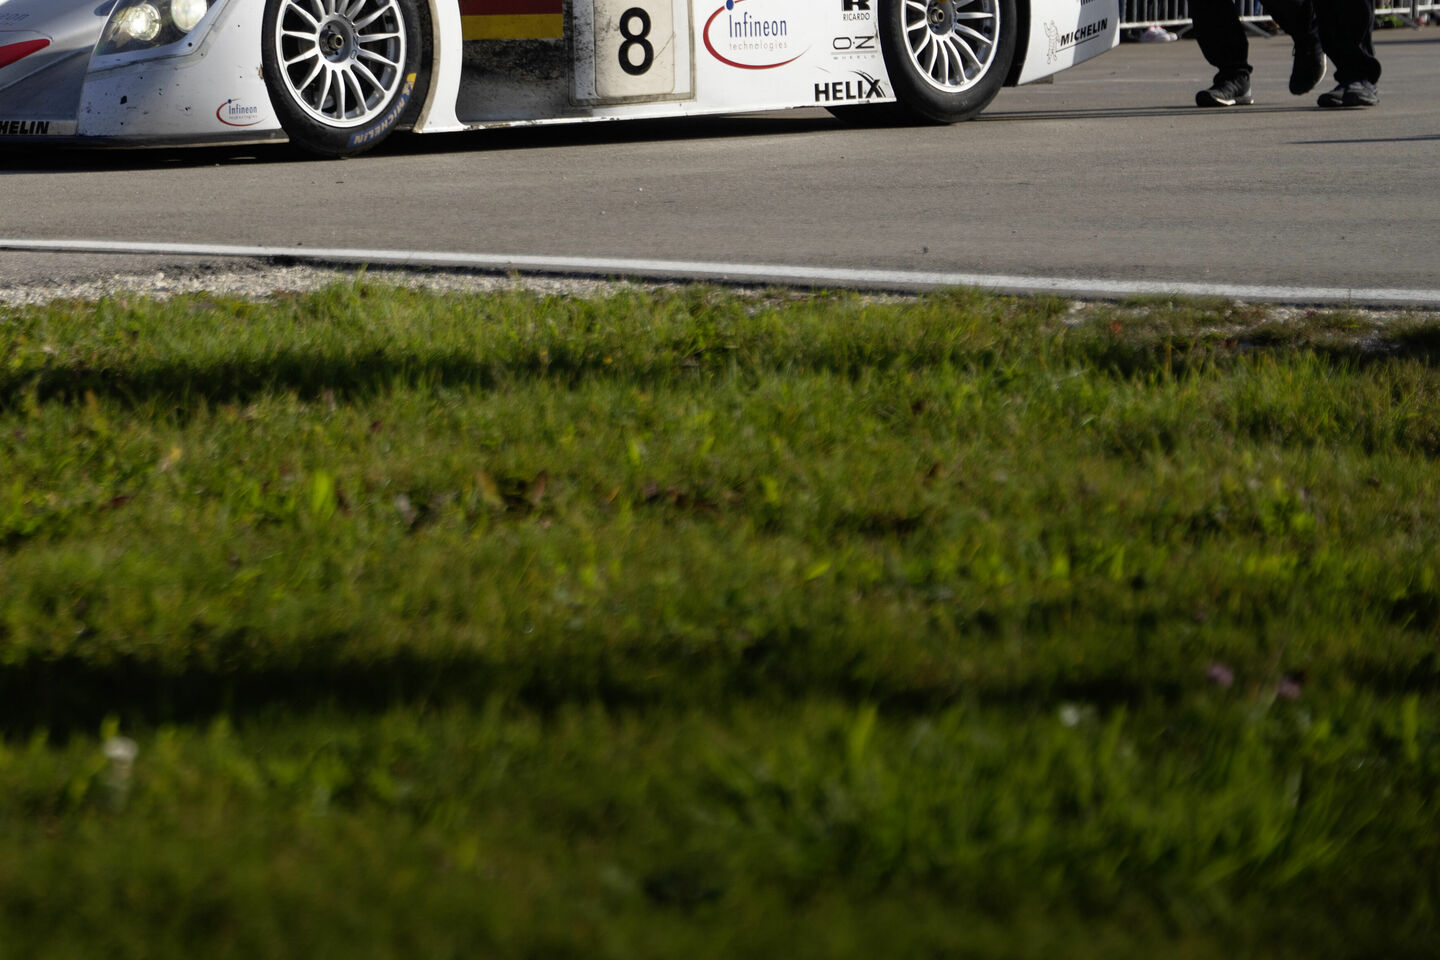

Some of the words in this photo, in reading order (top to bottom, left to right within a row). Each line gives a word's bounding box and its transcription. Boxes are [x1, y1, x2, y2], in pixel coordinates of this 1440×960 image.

[728, 11, 788, 38] Infineon
[842, 12, 871, 21] RICARDO
[618, 6, 654, 76] 8
[1060, 17, 1108, 47] MICHELIN
[729, 41, 788, 52] technologies
[814, 76, 886, 102] HELIX
[228, 103, 258, 115] Infineon
[353, 97, 407, 145] MICHELIN
